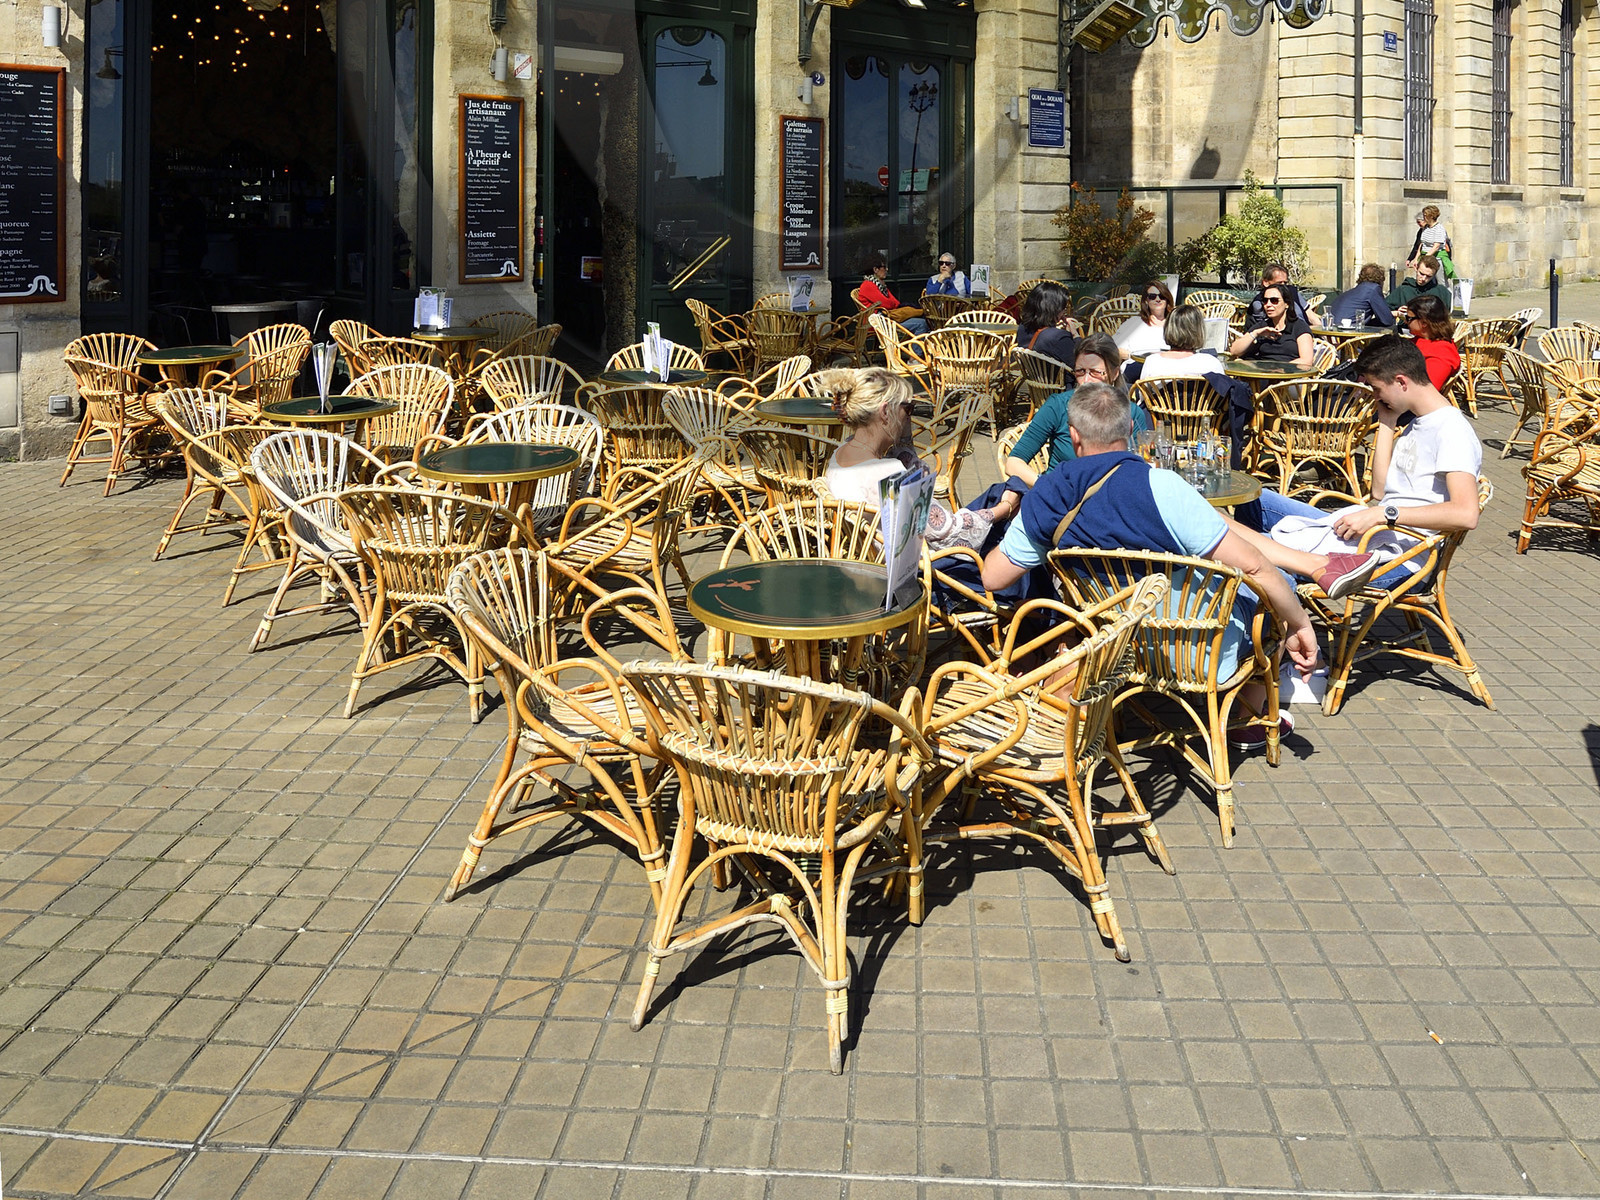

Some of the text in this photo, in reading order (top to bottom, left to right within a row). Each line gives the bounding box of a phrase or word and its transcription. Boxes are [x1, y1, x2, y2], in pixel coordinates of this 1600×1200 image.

[815, 73, 821, 84] 2
[467, 100, 511, 110] Jus de fruits
[468, 108, 506, 116] artisanaux
[786, 120, 806, 128] Galettes
[467, 147, 474, 157] À
[785, 201, 804, 209] Croque
[785, 215, 804, 223] Croque
[467, 230, 497, 238] Assiette
[785, 230, 807, 238] Lasagnes
